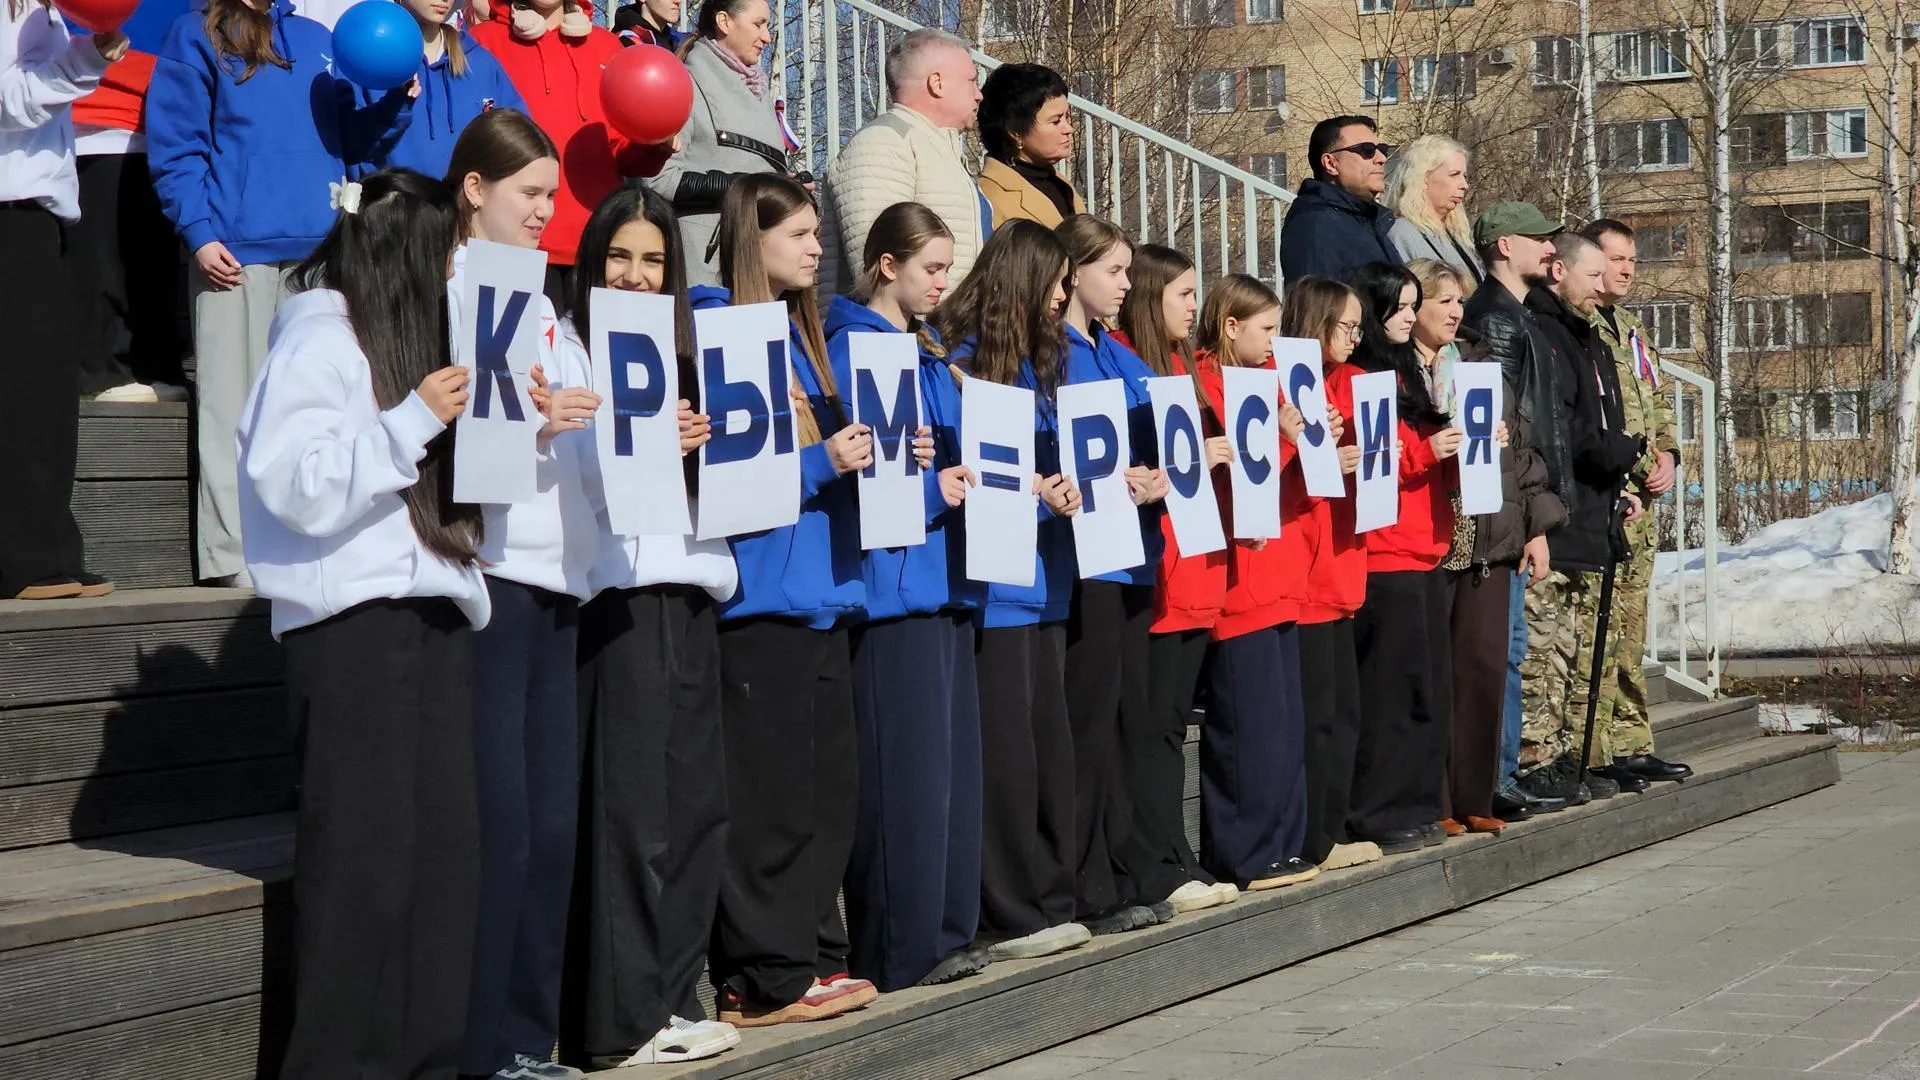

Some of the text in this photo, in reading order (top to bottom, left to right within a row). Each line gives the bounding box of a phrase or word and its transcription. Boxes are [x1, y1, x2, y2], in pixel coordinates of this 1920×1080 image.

[472, 284, 532, 422] К
[607, 331, 666, 457] Р
[702, 338, 794, 466] Ы
[855, 368, 920, 479] М
[1071, 413, 1119, 514] Р
[1164, 403, 1201, 499] О
[1235, 394, 1272, 486] С
[1289, 362, 1325, 449] С
[1360, 397, 1391, 481] И
[1464, 388, 1494, 466] Я
